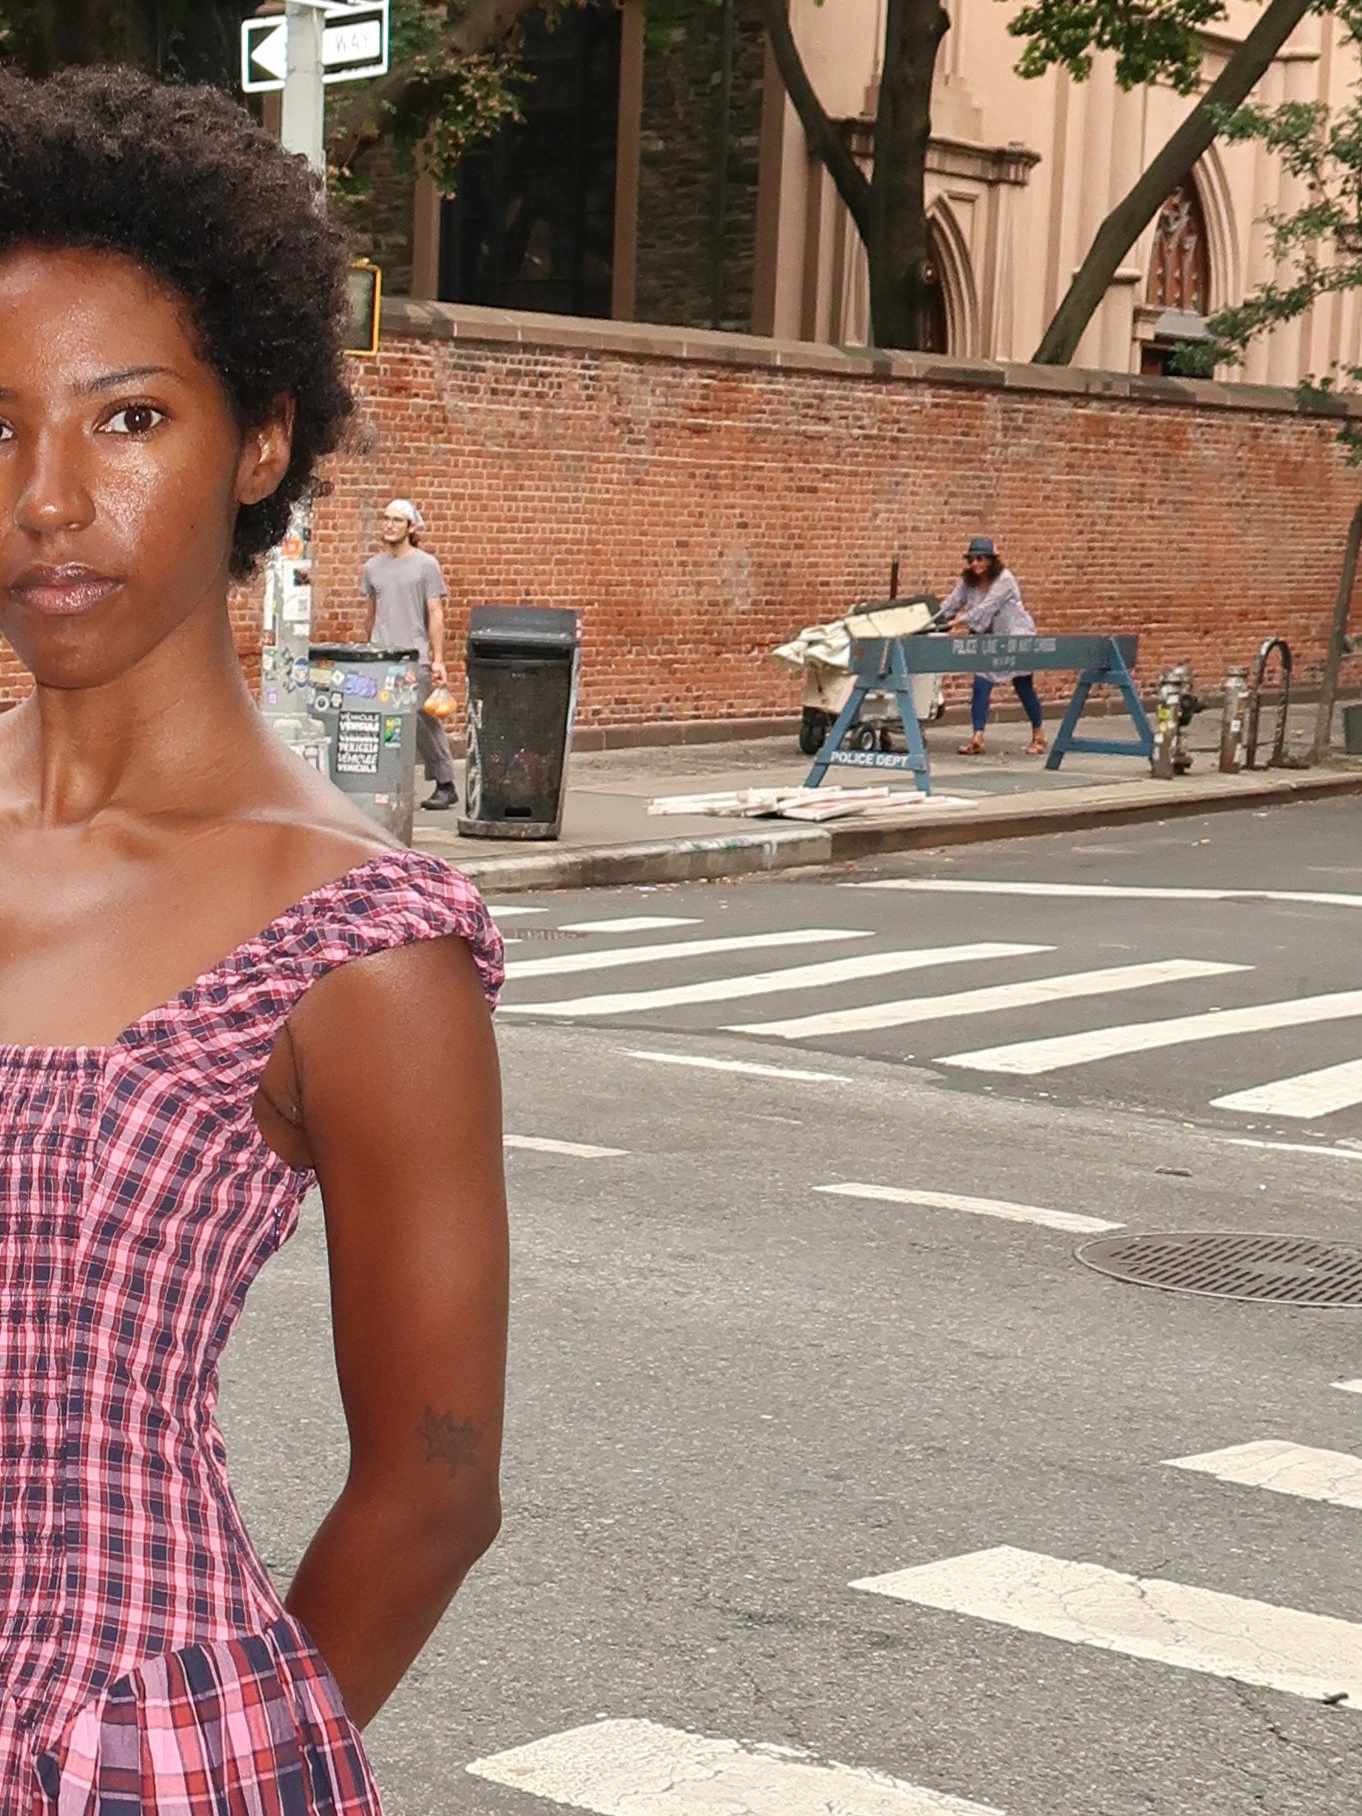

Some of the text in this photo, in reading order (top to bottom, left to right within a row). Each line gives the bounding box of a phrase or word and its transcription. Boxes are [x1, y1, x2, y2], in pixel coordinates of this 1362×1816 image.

[334, 31, 370, 54] WAY
[830, 751, 910, 767] POLICE DEPT
